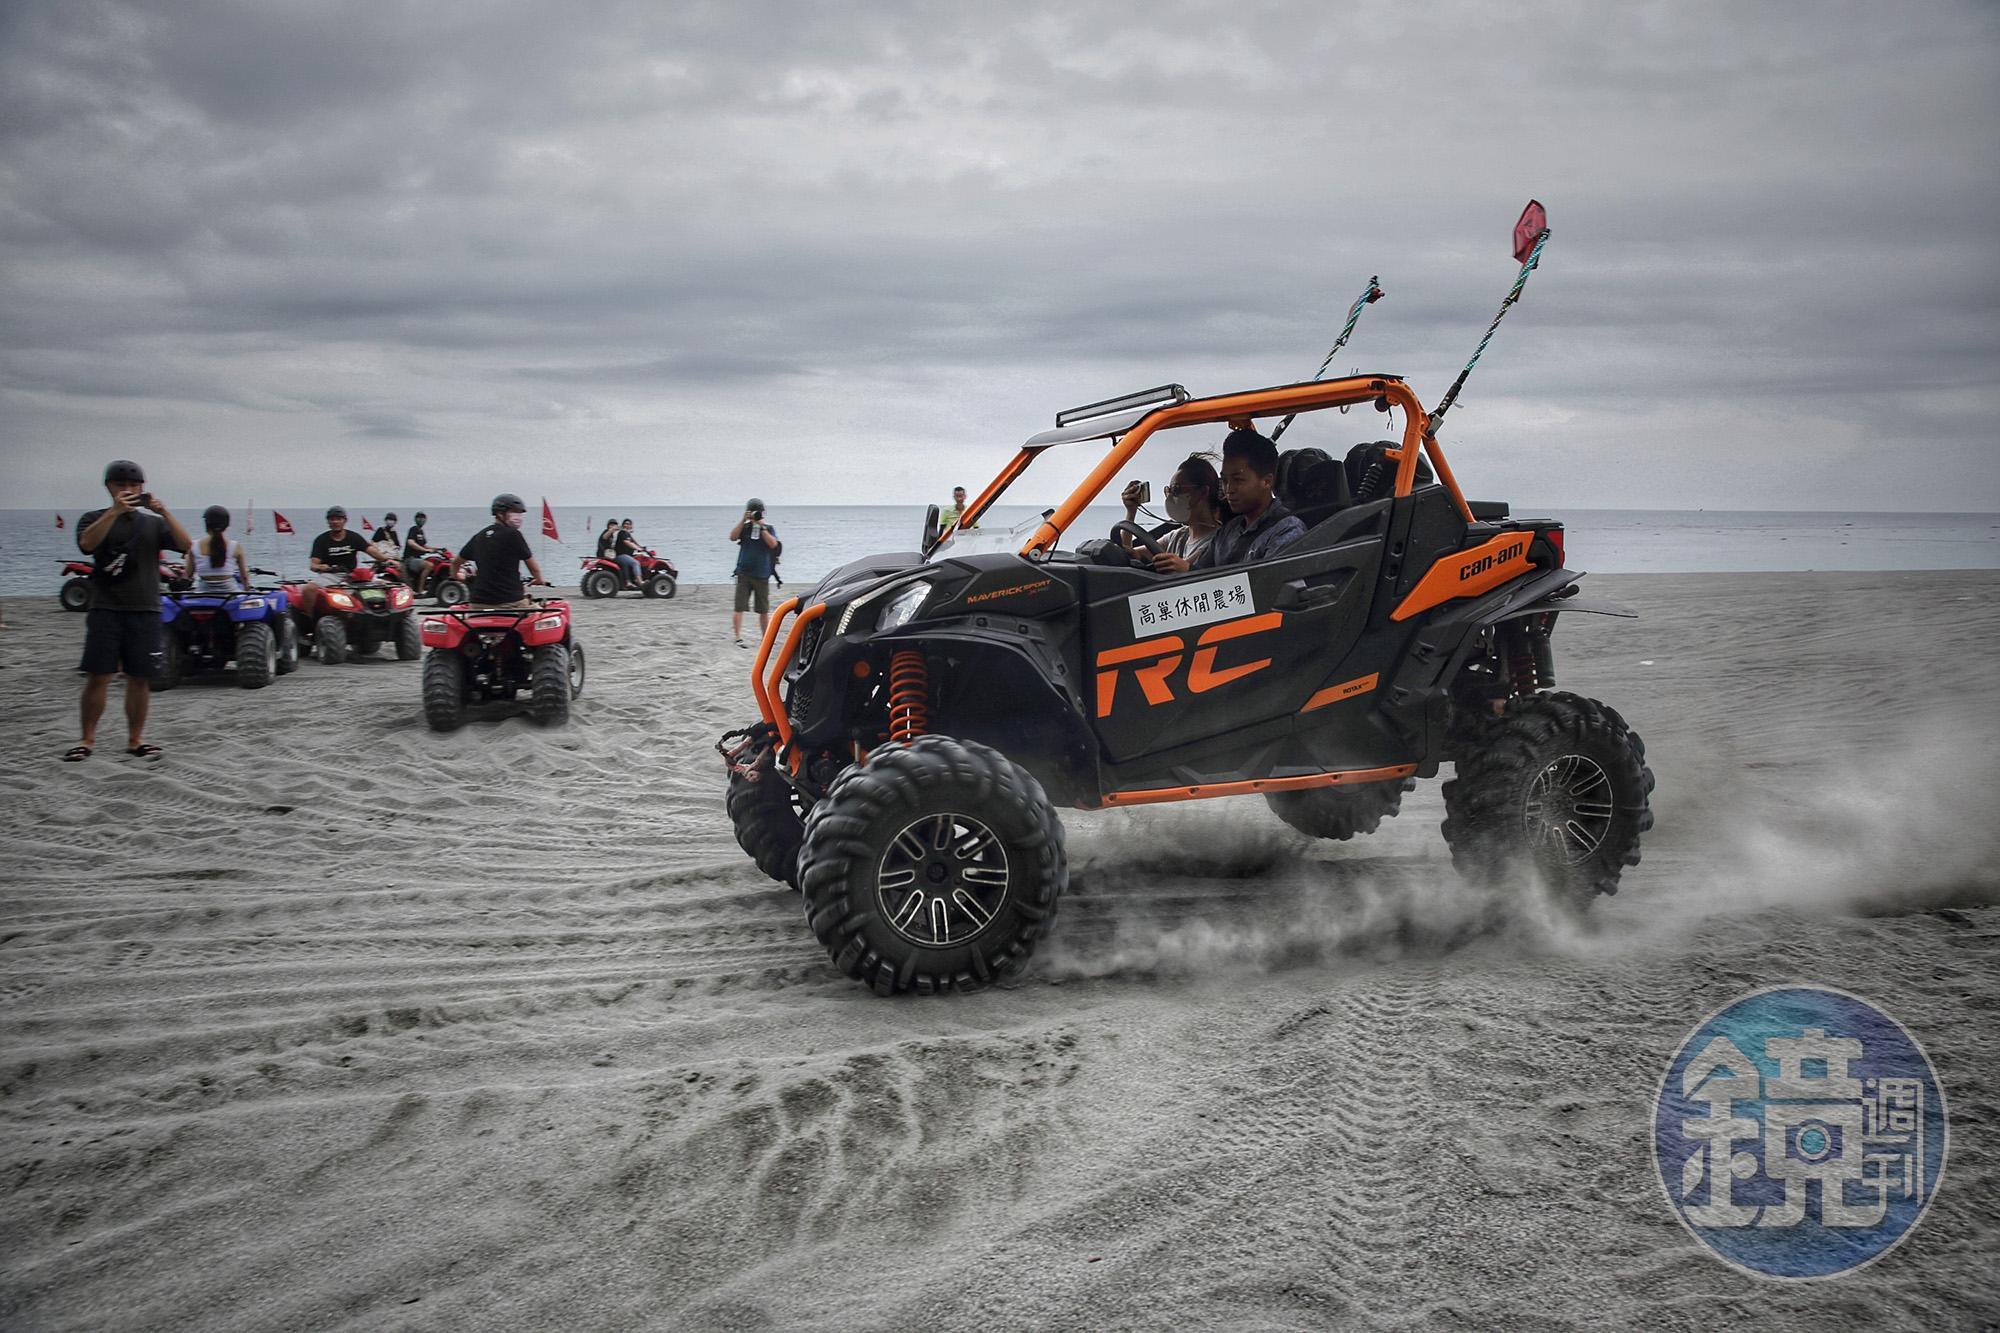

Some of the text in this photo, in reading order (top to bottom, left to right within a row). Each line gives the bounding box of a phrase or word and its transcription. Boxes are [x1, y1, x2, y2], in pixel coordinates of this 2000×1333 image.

[967, 586, 1023, 604] MAVERICK
[1138, 585, 1247, 626] 高巢休閒農場
[1096, 612, 1283, 718] RC
